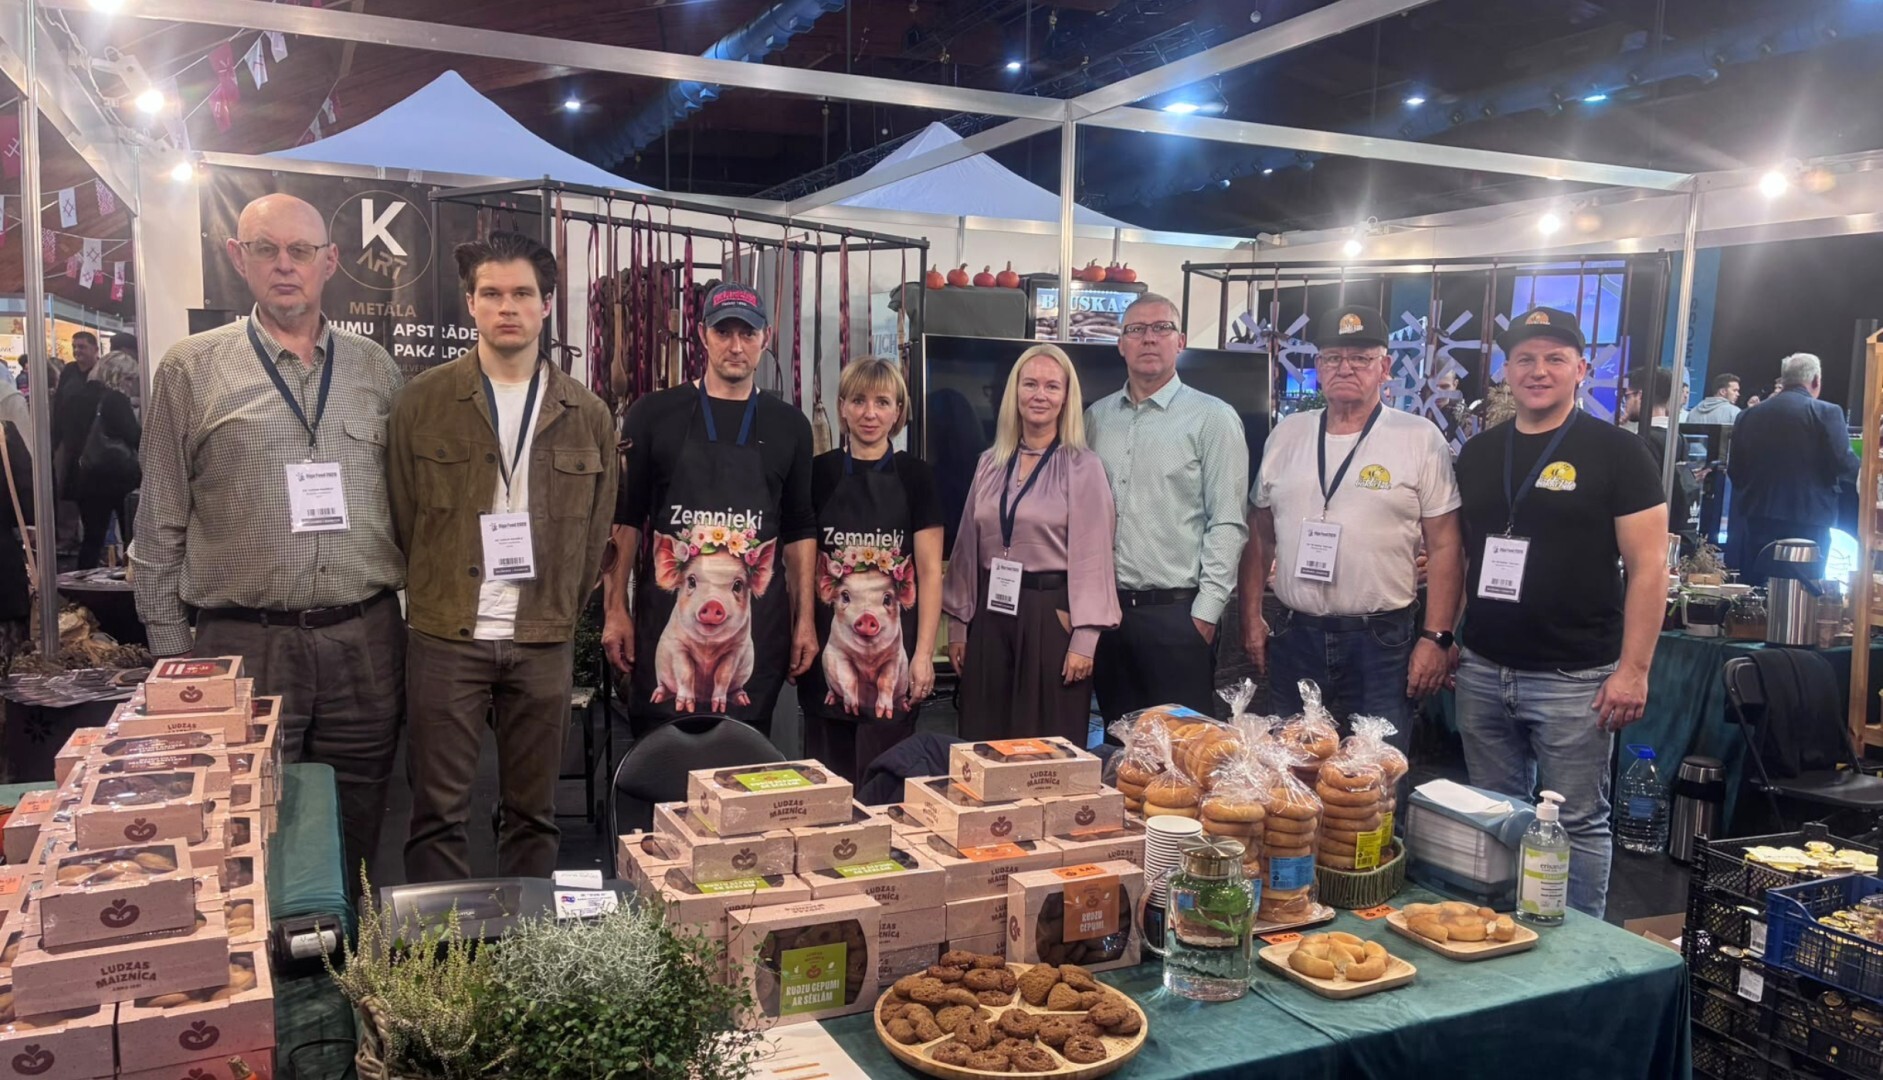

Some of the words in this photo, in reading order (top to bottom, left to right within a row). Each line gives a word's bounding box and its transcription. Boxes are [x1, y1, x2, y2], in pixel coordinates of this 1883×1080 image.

[361, 198, 408, 256] K
[356, 249, 408, 281] ART
[350, 301, 417, 317] METĀLA
[1041, 294, 1132, 313] BUSKAS
[670, 504, 763, 530] Zemnieki
[823, 526, 904, 549] Zemnieki
[1027, 777, 1060, 787] MAIZNĪCA
[1030, 770, 1057, 778] LUDZAS
[769, 805, 808, 818] MAIZNĪCA
[773, 799, 804, 809] LUDZAS
[991, 867, 1018, 875] LUDZAS
[865, 885, 896, 895] LUDZAS
[1082, 910, 1103, 922] RUDZU
[1080, 920, 1104, 933] CEPUMI
[100, 960, 150, 976] LUDZAS
[95, 971, 157, 989] MAIZNĪCA
[786, 983, 810, 996] RUDZU
[811, 979, 840, 993] CEPUMI
[792, 996, 803, 1007] AR
[803, 991, 833, 1005] SĒKLĀM
